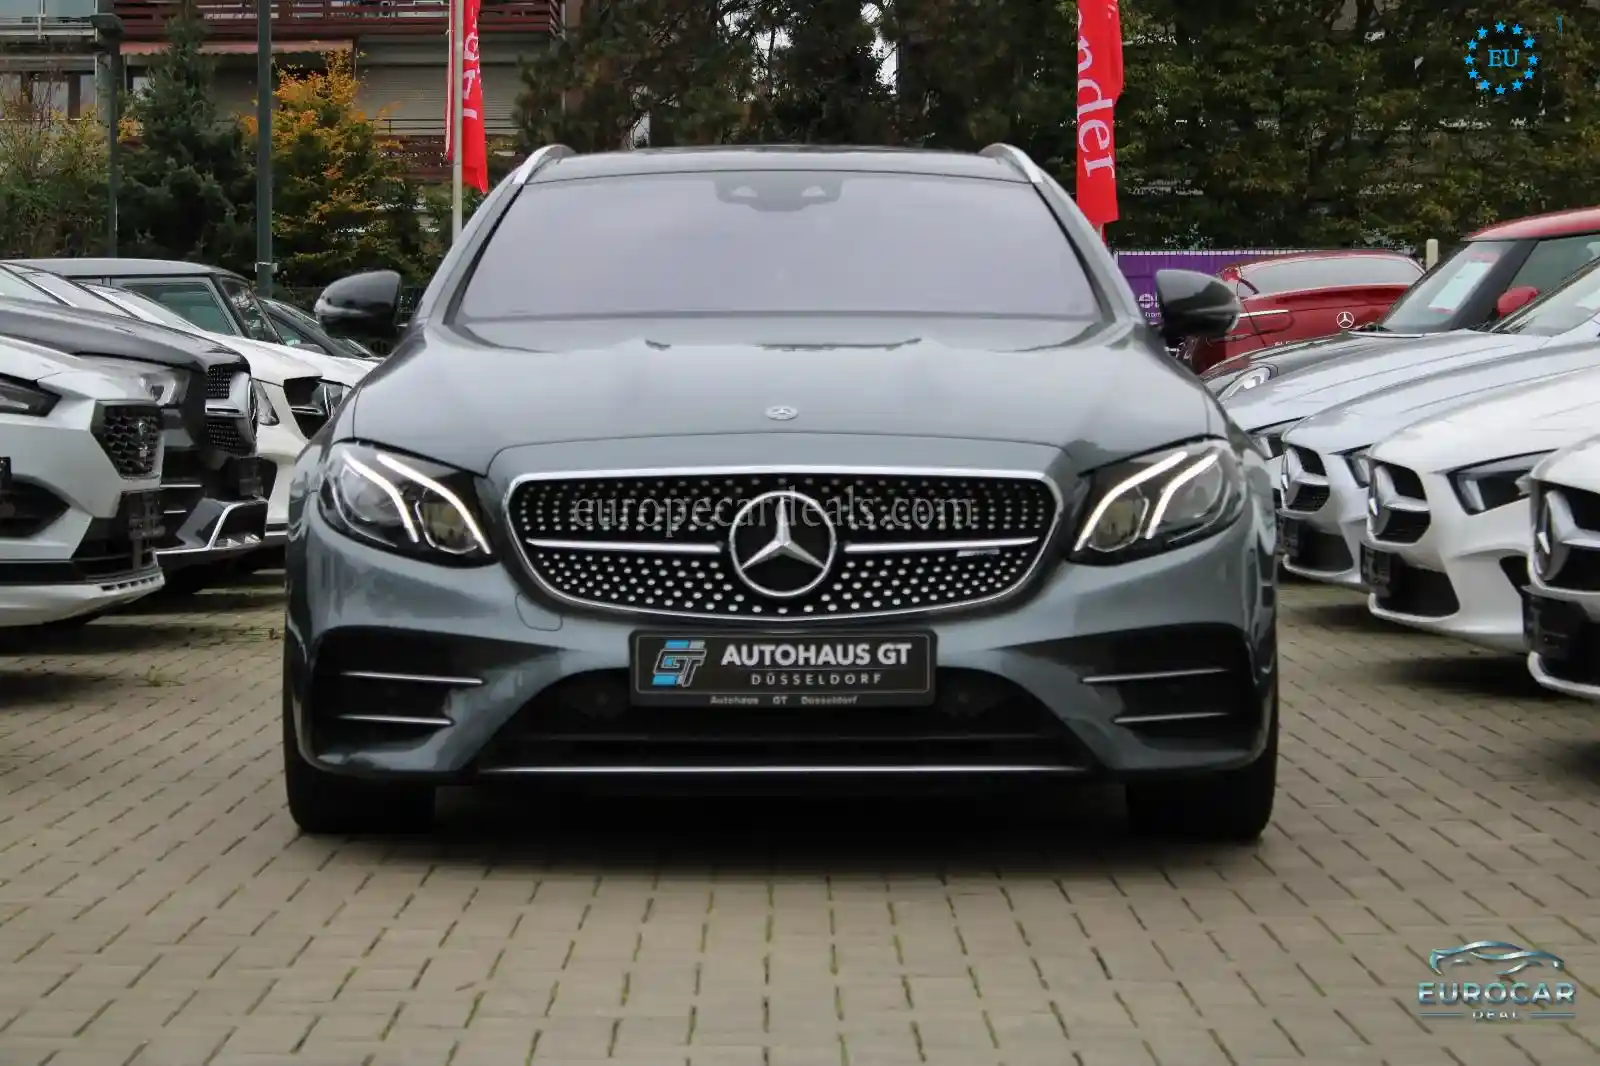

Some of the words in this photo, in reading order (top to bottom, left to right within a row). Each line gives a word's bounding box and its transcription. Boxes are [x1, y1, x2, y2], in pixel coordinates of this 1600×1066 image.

[721, 643, 871, 667] AUTOHAUS
[877, 643, 912, 665] GT
[751, 672, 882, 685] DÜSSELDORF
[772, 695, 789, 705] GT
